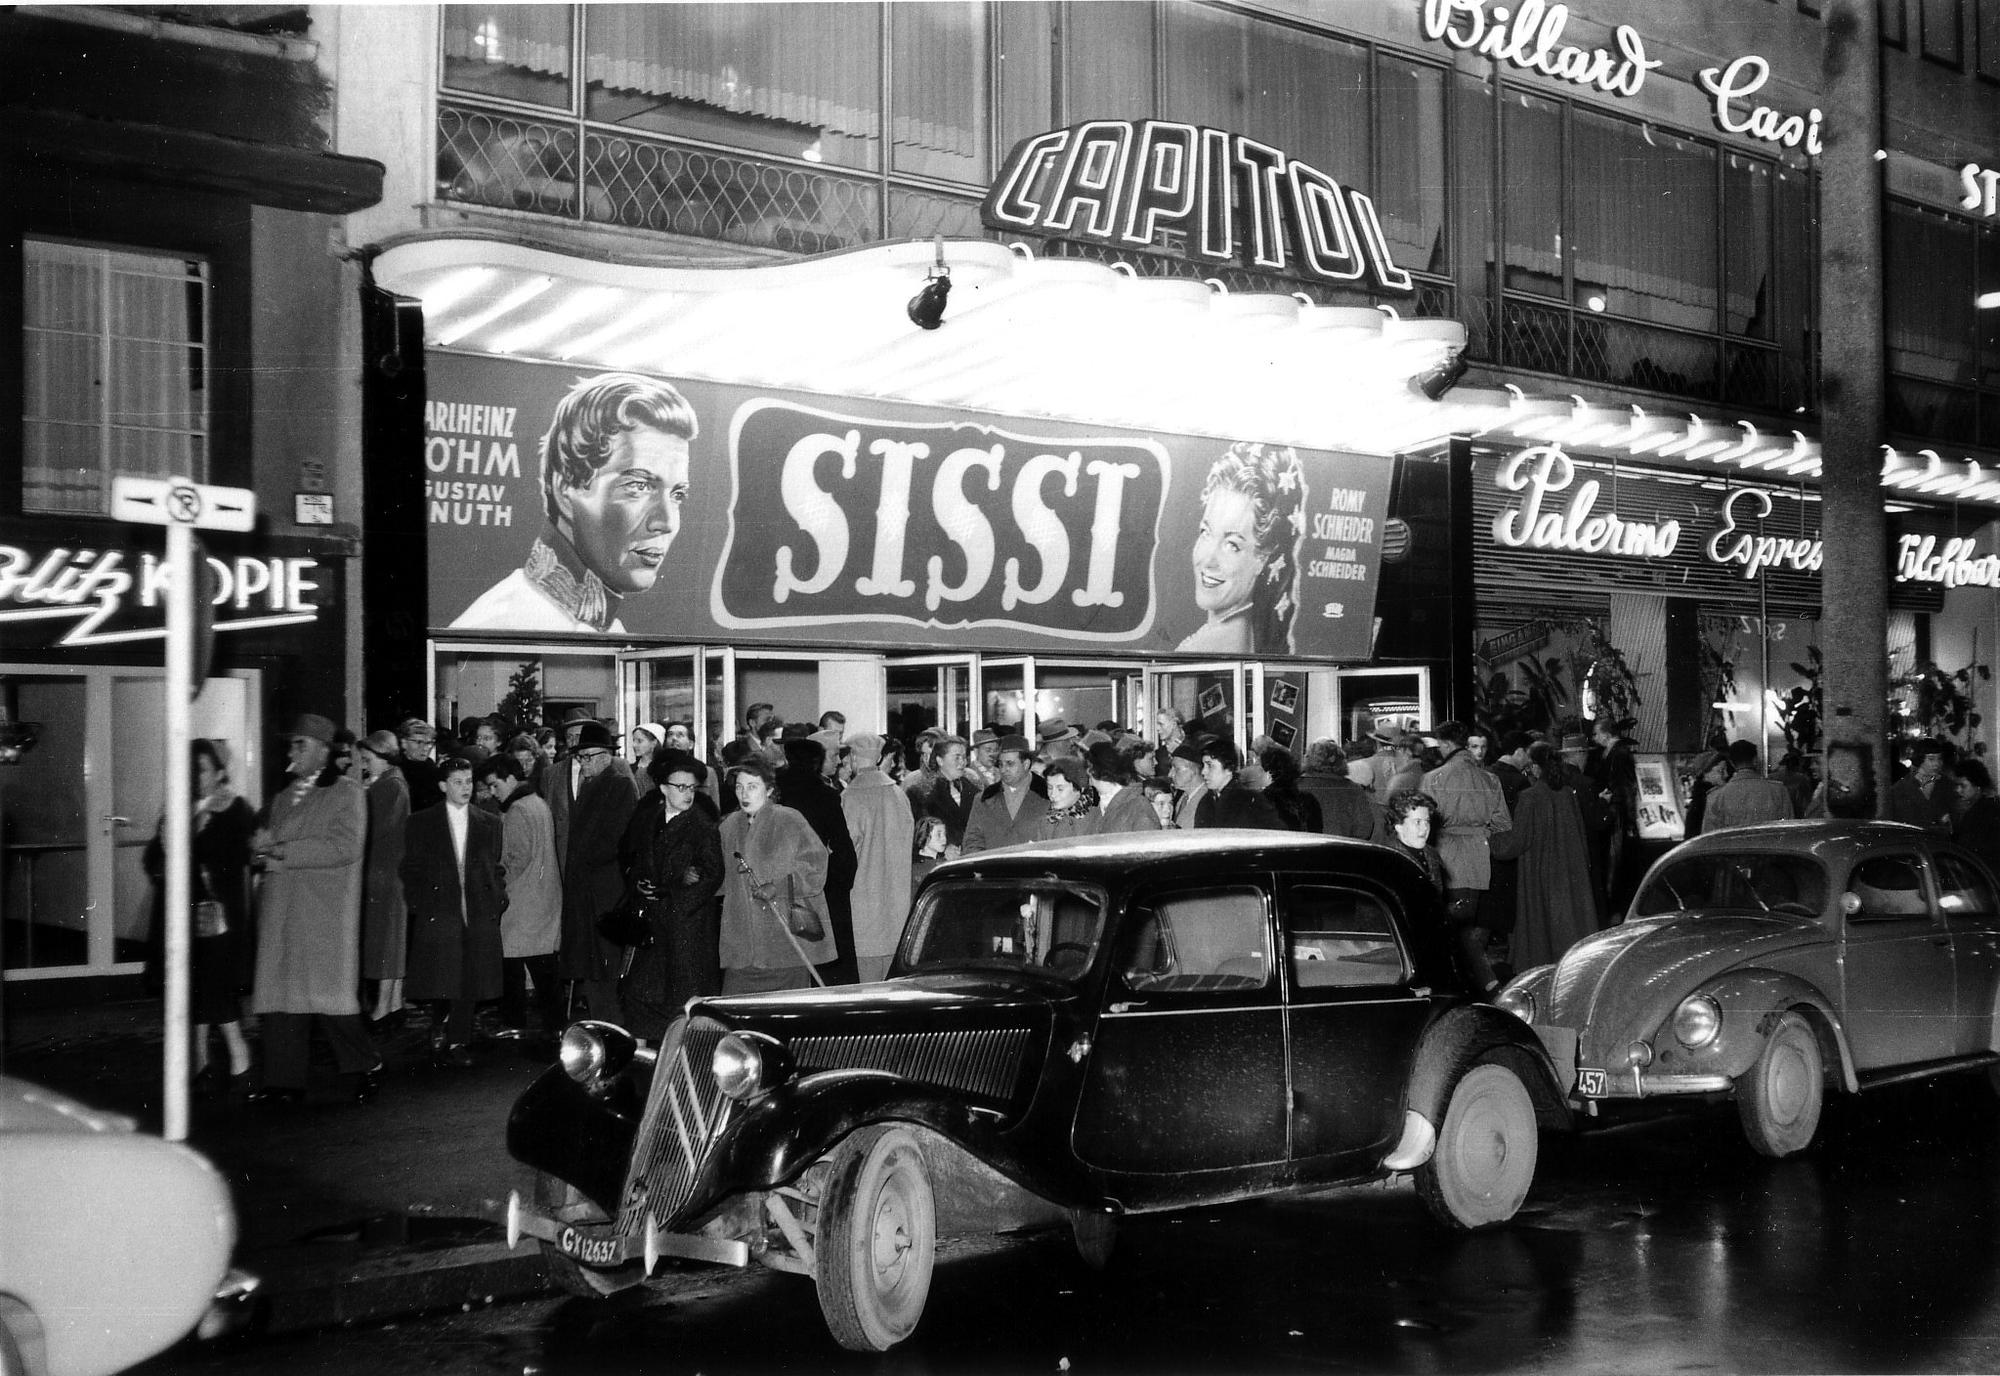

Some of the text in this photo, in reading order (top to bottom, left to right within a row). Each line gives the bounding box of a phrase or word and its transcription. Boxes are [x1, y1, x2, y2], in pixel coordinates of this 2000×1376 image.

[1424, 0, 1663, 96] Billard
[1700, 55, 1823, 155] Casi
[995, 120, 1413, 290] CAPITOL
[773, 429, 1141, 611] SISSI
[1311, 512, 1374, 544] SCHNEIDER
[1330, 487, 1367, 513] ROMY
[1497, 443, 1681, 557] Palermo
[1307, 560, 1367, 582] SCHNEIDER
[1578, 1071, 1604, 1094] 457
